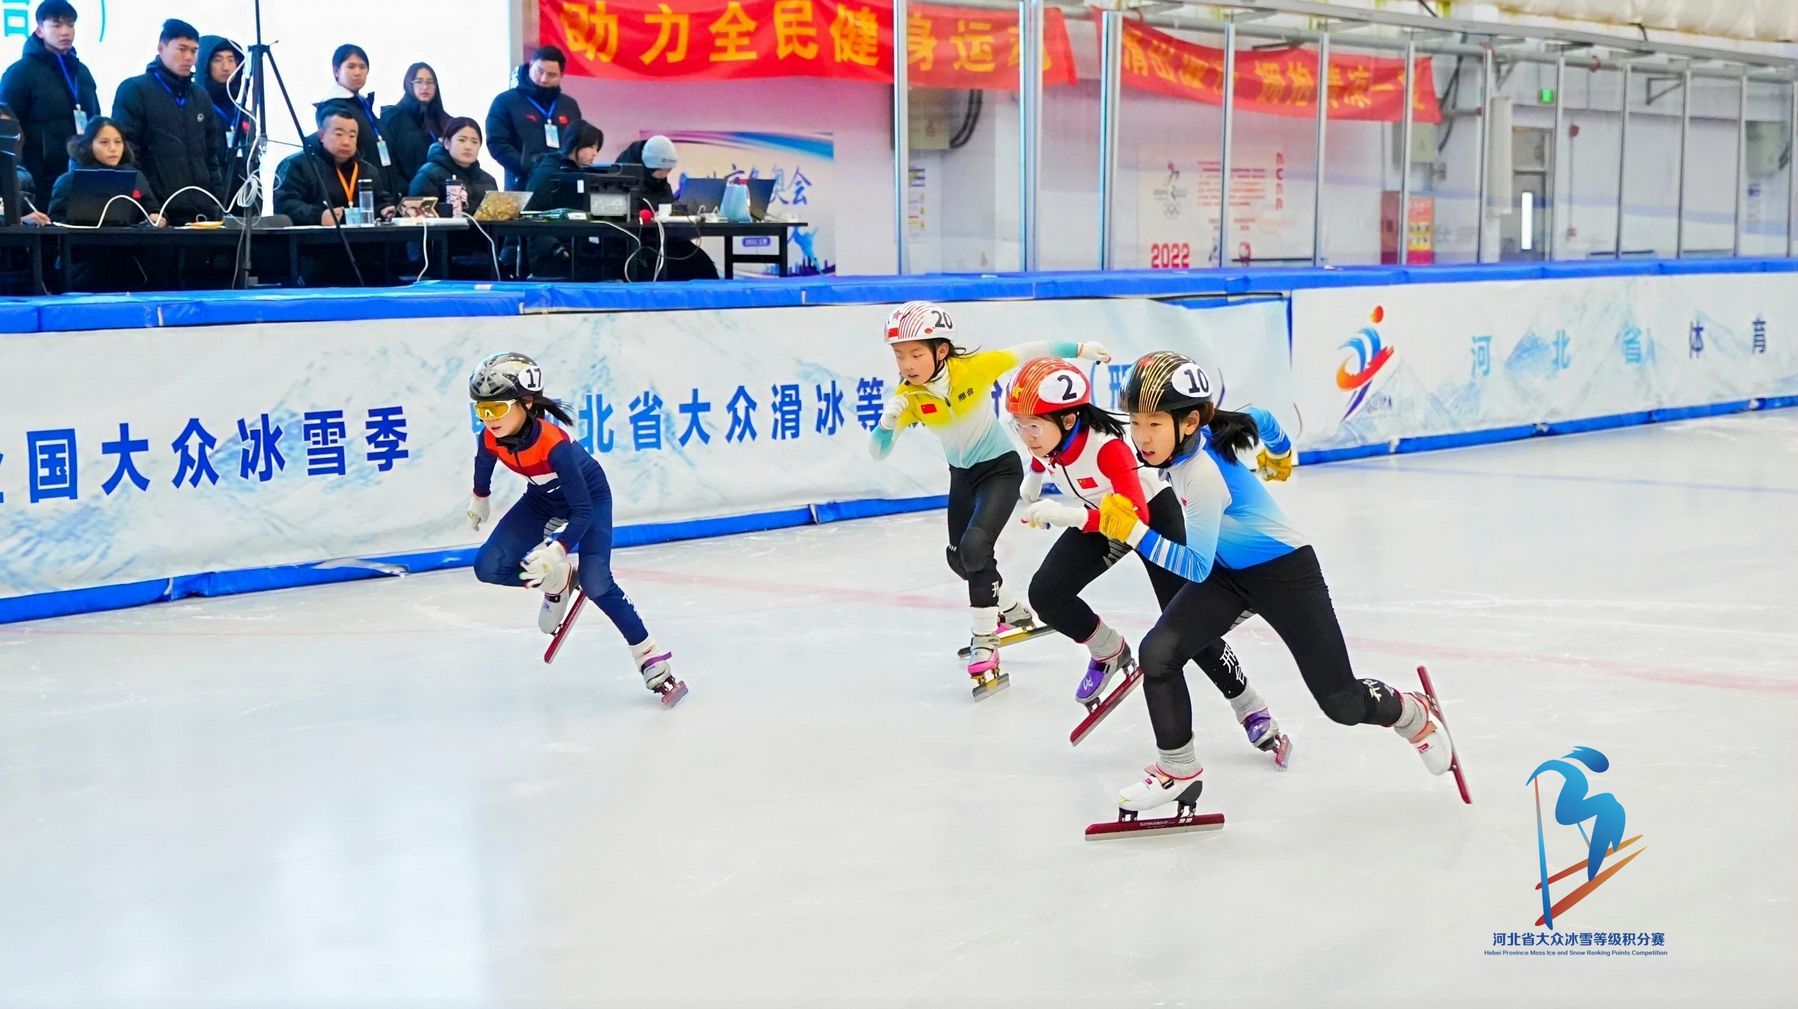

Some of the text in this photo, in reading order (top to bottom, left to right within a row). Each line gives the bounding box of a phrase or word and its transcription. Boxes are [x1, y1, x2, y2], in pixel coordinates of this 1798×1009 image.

[1151, 243, 1190, 269] 2022
[931, 310, 953, 330] 20
[525, 367, 542, 389] 17
[1056, 374, 1078, 401] 2
[1183, 367, 1210, 394] 10
[0, 406, 409, 504] 国大众冰雪季
